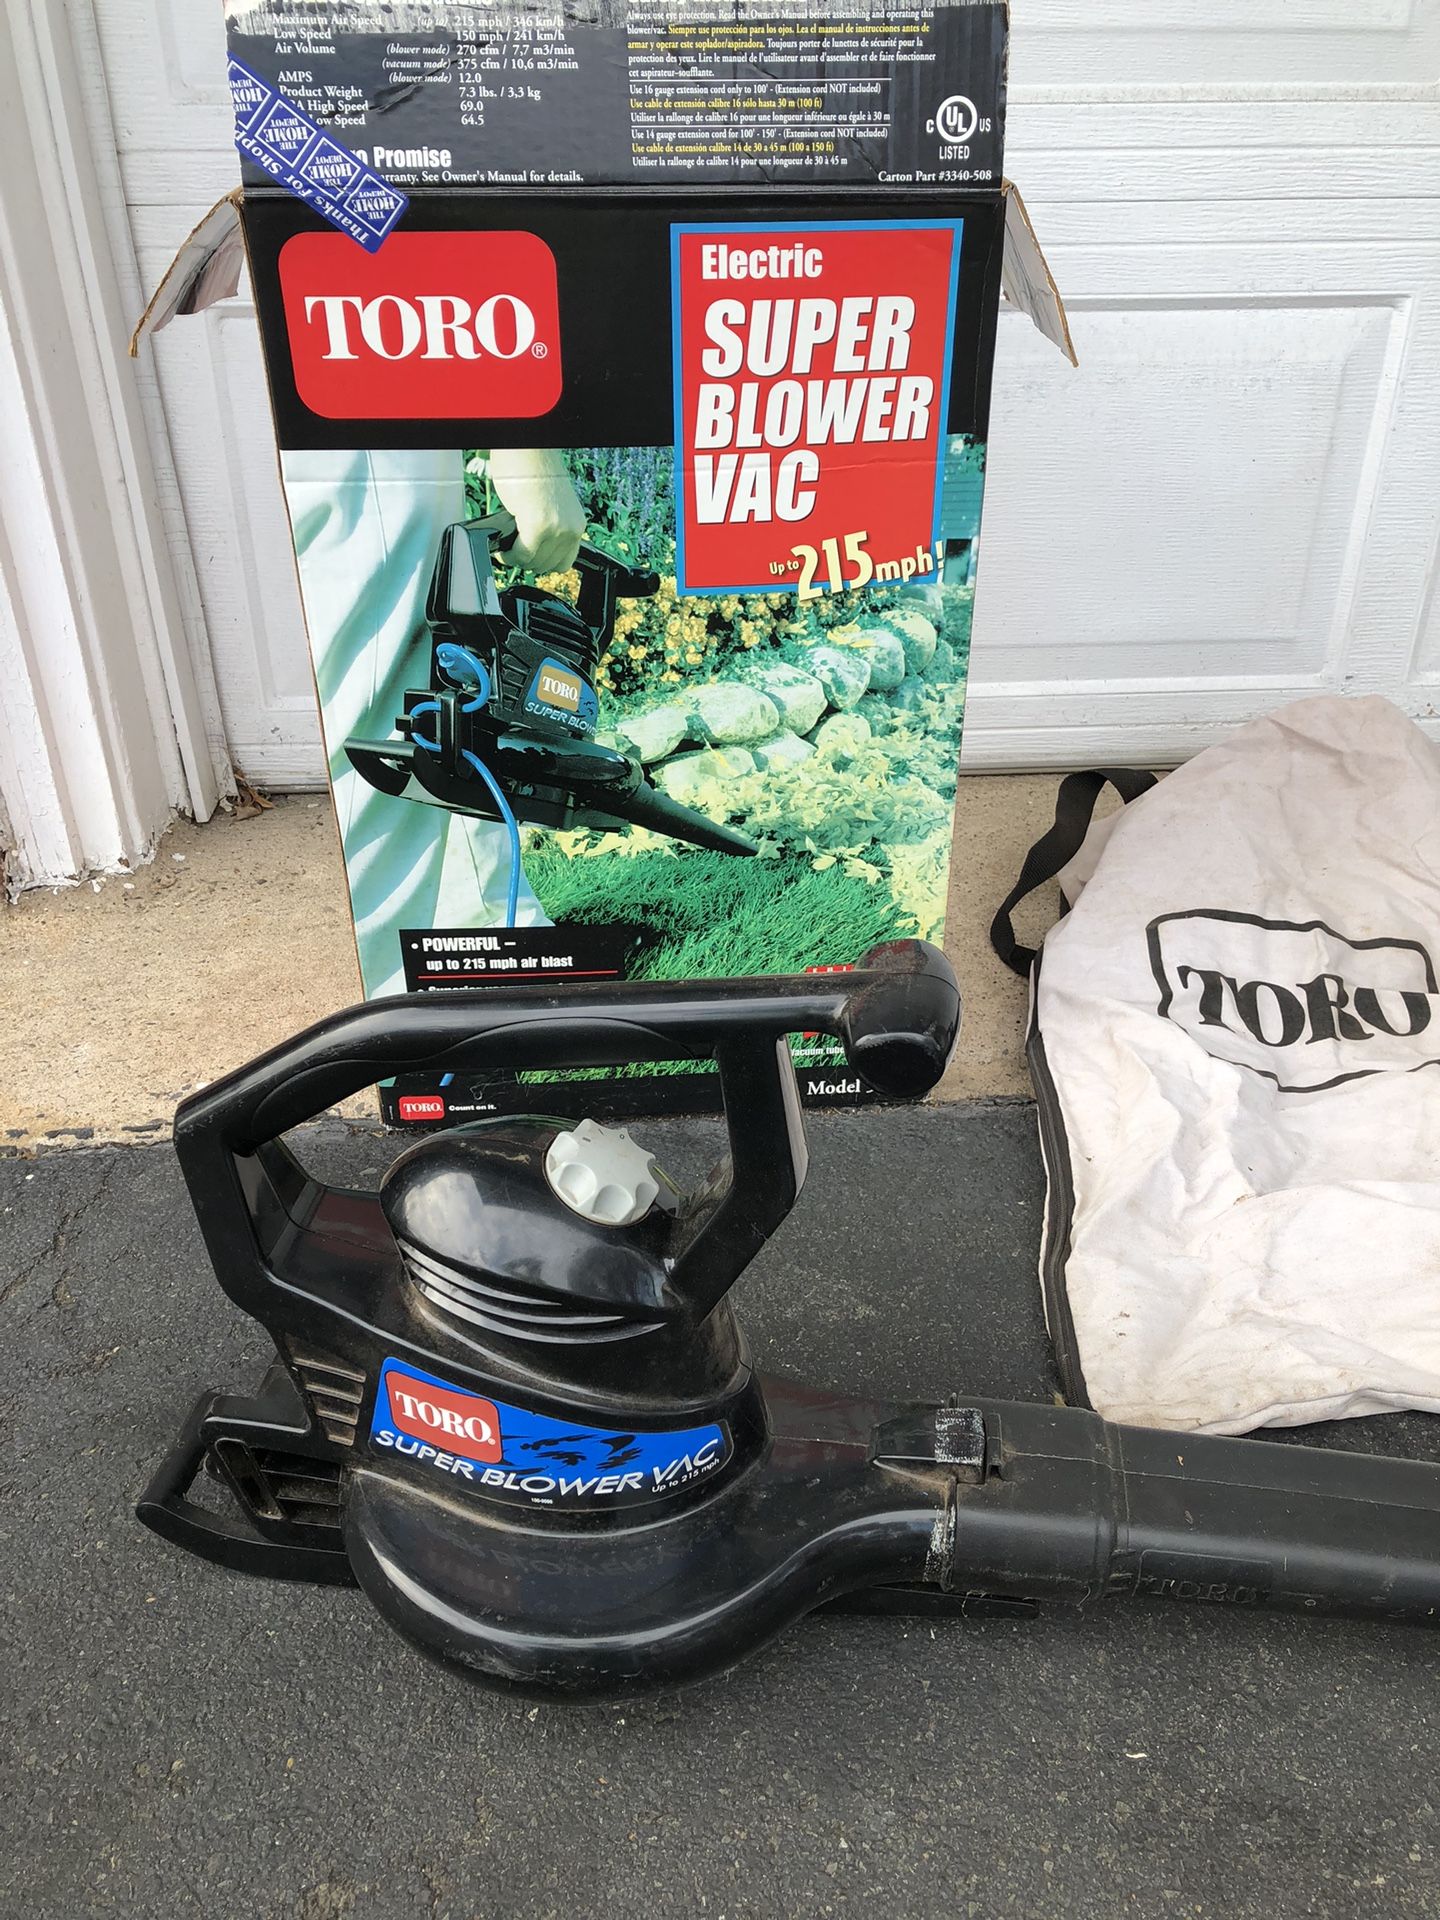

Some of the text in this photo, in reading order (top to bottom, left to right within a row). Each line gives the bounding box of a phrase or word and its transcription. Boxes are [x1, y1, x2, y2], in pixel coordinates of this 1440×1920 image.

[272, 13, 328, 25] Maximum
[331, 13, 348, 25] Air
[454, 16, 475, 27] 215
[478, 16, 502, 30] mph
[513, 16, 533, 27] 346
[535, 15, 564, 27] km/h
[274, 28, 565, 44] Low Speed 150 mph 241 km/h
[275, 41, 575, 58] Air Volume (blower mode) 270 cfm 7,7 m3/min
[381, 58, 579, 72] (vacuum mode) 375 cfm 10,6 m3/min
[628, 51, 936, 66] protection des yeux. Lire le manuel de l'utilisateur avant d'assembler et de faire fonctionner
[278, 71, 482, 84] AMPS (blower mode) 12.0
[628, 69, 639, 77] cet
[280, 85, 541, 101] Product Weight 7.3 lbs. 3,3 kg
[629, 85, 642, 94] Use
[644, 85, 653, 94] 16
[654, 87, 675, 97] gauge
[676, 85, 708, 94] extension
[710, 85, 726, 94] cord
[727, 85, 742, 96] only
[744, 86, 752, 94] to
[775, 84, 811, 95] (Extension
[813, 83, 827, 94] cord
[829, 83, 847, 93] NOT
[849, 83, 881, 95] included)
[308, 100, 336, 114] High
[337, 100, 369, 114] Speed
[460, 101, 484, 111] 69.0
[334, 114, 366, 128] Speed
[461, 114, 485, 126] 64.5
[979, 118, 991, 132] US
[264, 127, 308, 144] HOME
[631, 130, 644, 139] Use
[646, 130, 655, 139] 14
[656, 131, 676, 141] gauge
[678, 130, 710, 139] extension
[711, 129, 727, 139] cord
[728, 129, 739, 139] for
[783, 129, 818, 139] (Extension
[820, 128, 835, 138] cord
[837, 128, 855, 138] NOT
[856, 128, 888, 138] included)
[279, 143, 297, 151] THE
[939, 145, 970, 160] LISTED
[373, 146, 452, 168] Promise
[308, 164, 352, 179] HOME
[422, 171, 439, 182] See
[442, 171, 485, 183] Owner's
[487, 171, 527, 182] Manual
[530, 170, 545, 182] for
[546, 171, 584, 182] details.
[878, 169, 992, 182] Carton Part #3340-508
[283, 174, 314, 196] For
[353, 197, 395, 212] HOME
[315, 197, 369, 245] Thanks
[368, 211, 385, 219] THE
[701, 243, 823, 280] Electric
[701, 295, 916, 379] SUPER
[694, 376, 934, 450] BLOWER
[693, 449, 820, 524] VAC
[769, 530, 945, 601] Up to 215 mph!
[525, 702, 568, 722] SUPER
[422, 937, 501, 952] POWERFUL
[426, 955, 573, 971] up to 215 mph air blast
[807, 1079, 861, 1096] Model
[403, 1103, 440, 1113] TORO
[395, 1391, 492, 1444] TORO
[375, 1430, 718, 1497] SUPER BLOWER VAC
[652, 1458, 720, 1493] Up to 215 mph
